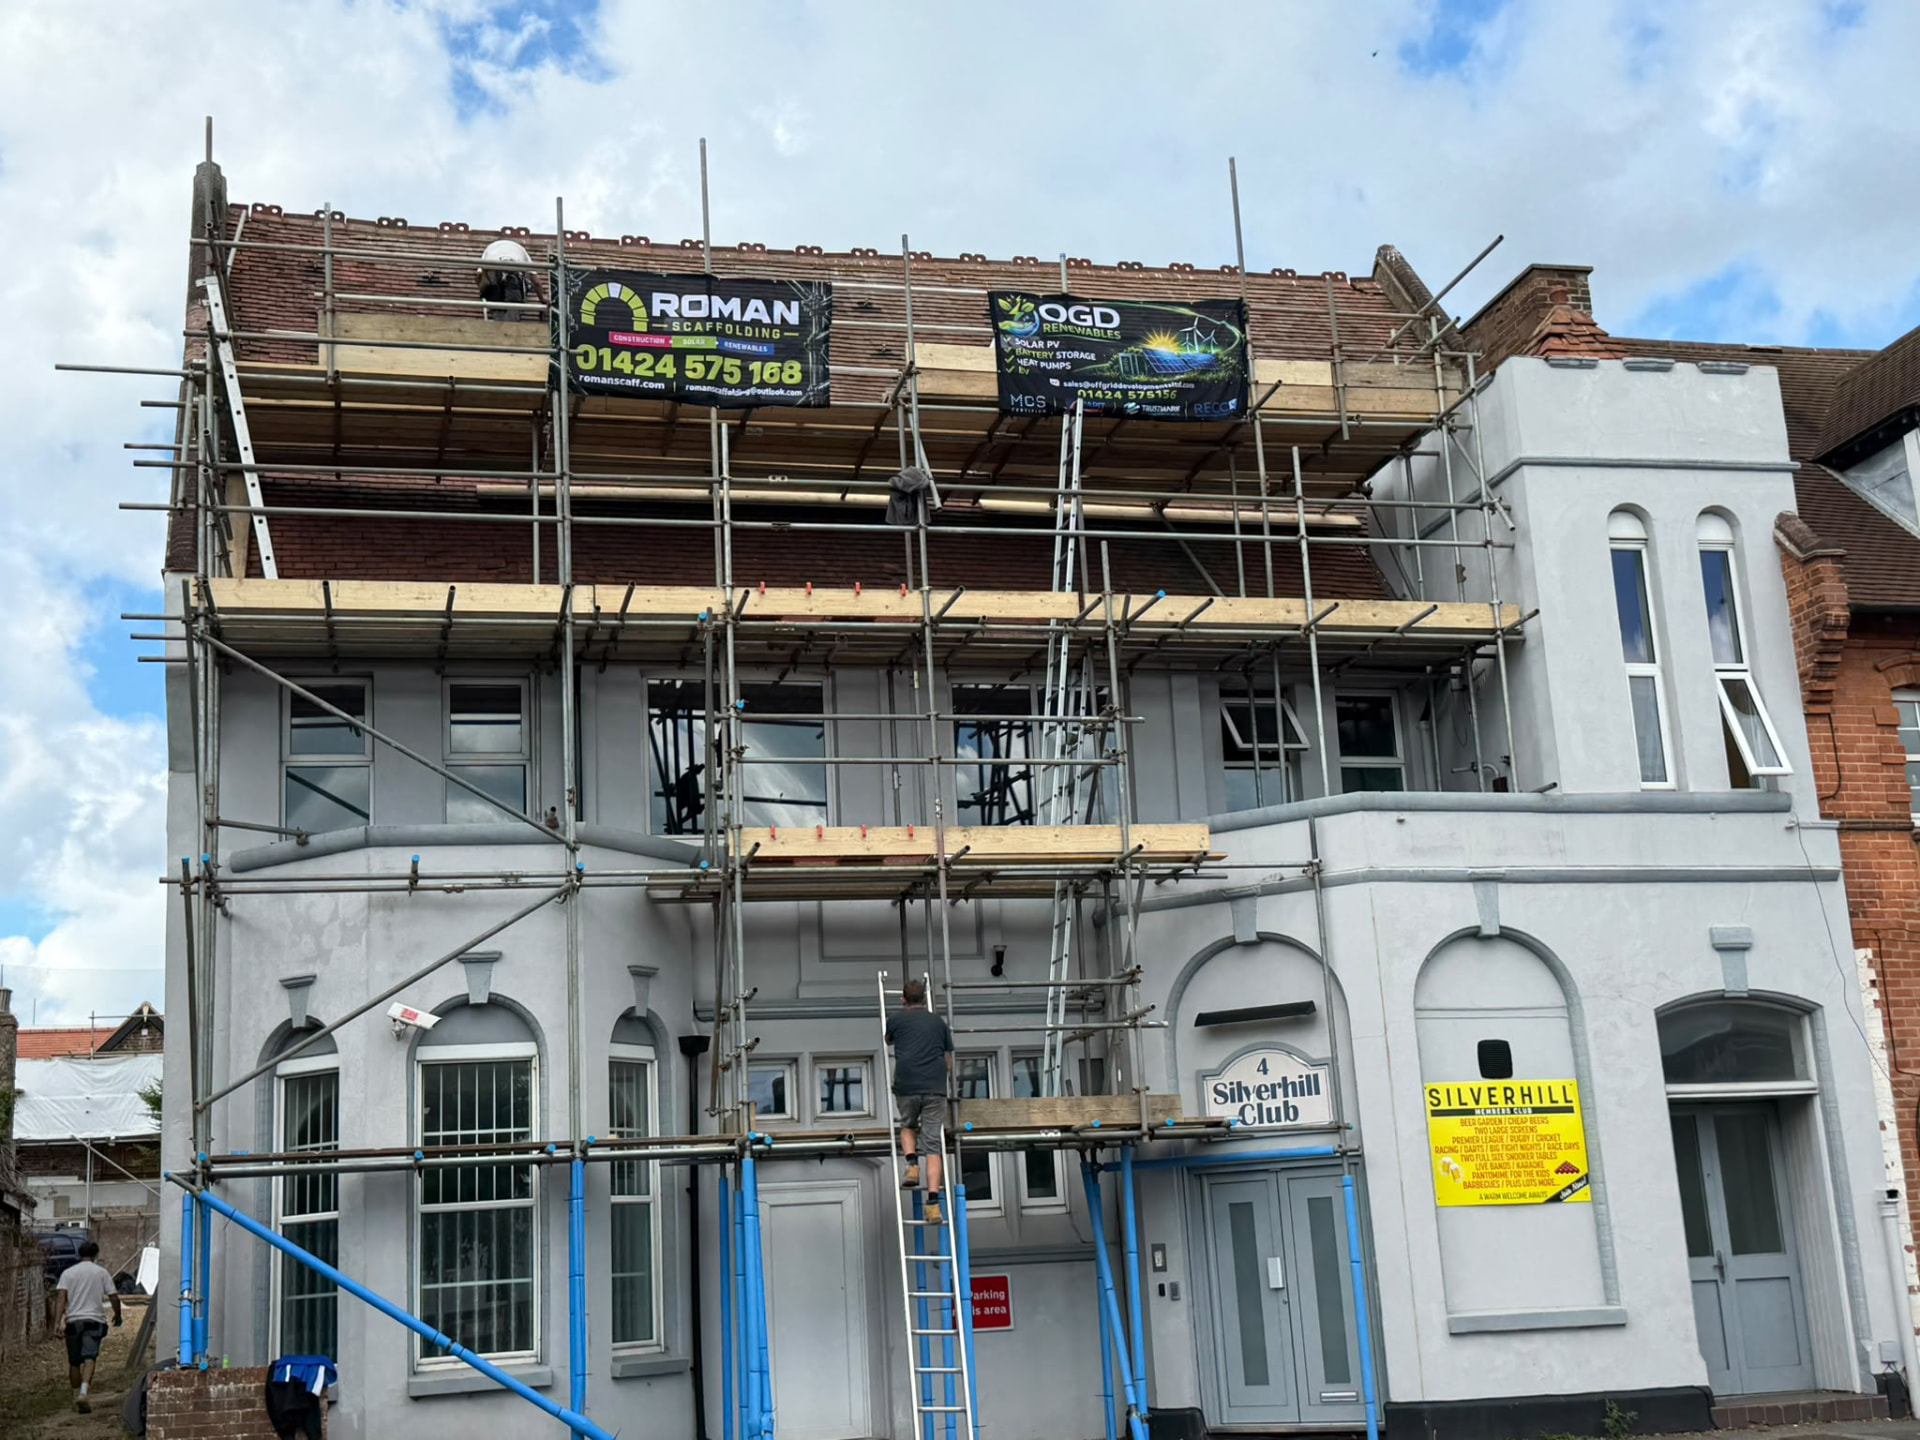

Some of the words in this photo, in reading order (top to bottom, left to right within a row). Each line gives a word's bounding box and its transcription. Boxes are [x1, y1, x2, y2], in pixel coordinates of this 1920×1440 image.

[652, 292, 799, 325] ROMAN
[1039, 303, 1120, 329] OGD
[672, 322, 781, 340] SCAFFOLDING
[1043, 323, 1121, 340] RENEWABLES
[613, 335, 665, 345] CONSTRUCTION
[682, 338, 706, 346] SOLAR
[1015, 338, 1044, 349] SOLAR
[1047, 341, 1060, 349] PV
[723, 341, 768, 353] RENEWABLES
[1016, 348, 1054, 359] BATTERY
[1056, 351, 1096, 361] STORAGE
[576, 344, 677, 379] 01424
[685, 355, 742, 385] 575
[749, 360, 803, 385] 168
[1017, 358, 1038, 367] HEAT
[1041, 361, 1071, 370] PUMPS
[579, 374, 665, 390] romanscaff.com
[1077, 389, 1123, 399] 01424
[1128, 389, 1177, 400] 575156
[1010, 393, 1047, 409] MCS
[1256, 1057, 1270, 1075] 4
[1213, 1073, 1321, 1105] Silverhill
[1428, 1085, 1574, 1107] SILVERHILL
[1238, 1100, 1299, 1126] Club
[1474, 1108, 1511, 1116] MEMBERS
[1513, 1107, 1533, 1115] CLUB
[1460, 1118, 1476, 1127] BEER
[1478, 1117, 1503, 1126] GARDEN
[1508, 1117, 1528, 1125] CHEAP
[1530, 1116, 1549, 1125] BEERS
[1475, 1127, 1488, 1135] TWO
[1490, 1126, 1509, 1135] LARGE
[1510, 1125, 1538, 1134] SCREENS
[1452, 1136, 1480, 1145] PREMIER
[1481, 1135, 1504, 1144] LEAGUE
[1510, 1134, 1531, 1143] RUGBY
[1536, 1133, 1560, 1142] CRICKET
[1435, 1145, 1459, 1155] RACING
[1464, 1144, 1485, 1153] DARTS
[1490, 1144, 1501, 1152] BIG
[1502, 1143, 1518, 1152] FIGHT
[1520, 1142, 1542, 1151] NIGHTS
[1547, 1142, 1563, 1151] RACE
[1564, 1141, 1580, 1150] DAYS
[1461, 1154, 1474, 1163] TWO
[1476, 1153, 1490, 1162] FULL
[1491, 1153, 1505, 1161] SIZE
[1505, 1152, 1535, 1161] SNOOKER
[1536, 1151, 1557, 1160] TABLES
[1475, 1162, 1488, 1171] LIVE
[1490, 1161, 1511, 1170] BANDS
[1516, 1160, 1545, 1169] KARAOKE
[1472, 1171, 1509, 1180] PANTOMIME
[1510, 1170, 1522, 1179] FOR
[1523, 1169, 1534, 1178] THE
[1536, 1169, 1550, 1178] KIDS
[1463, 1180, 1500, 1189] BARBECUES
[1505, 1179, 1522, 1188] PLUS
[1523, 1178, 1537, 1187] LOTS
[1479, 1193, 1484, 1201] A
[1485, 1192, 1501, 1201] WARM
[1502, 1191, 1528, 1200] WELCOME
[1529, 1190, 1548, 1199] AWAITS
[971, 1290, 1005, 1301] arking
[984, 1306, 1007, 1315] area
